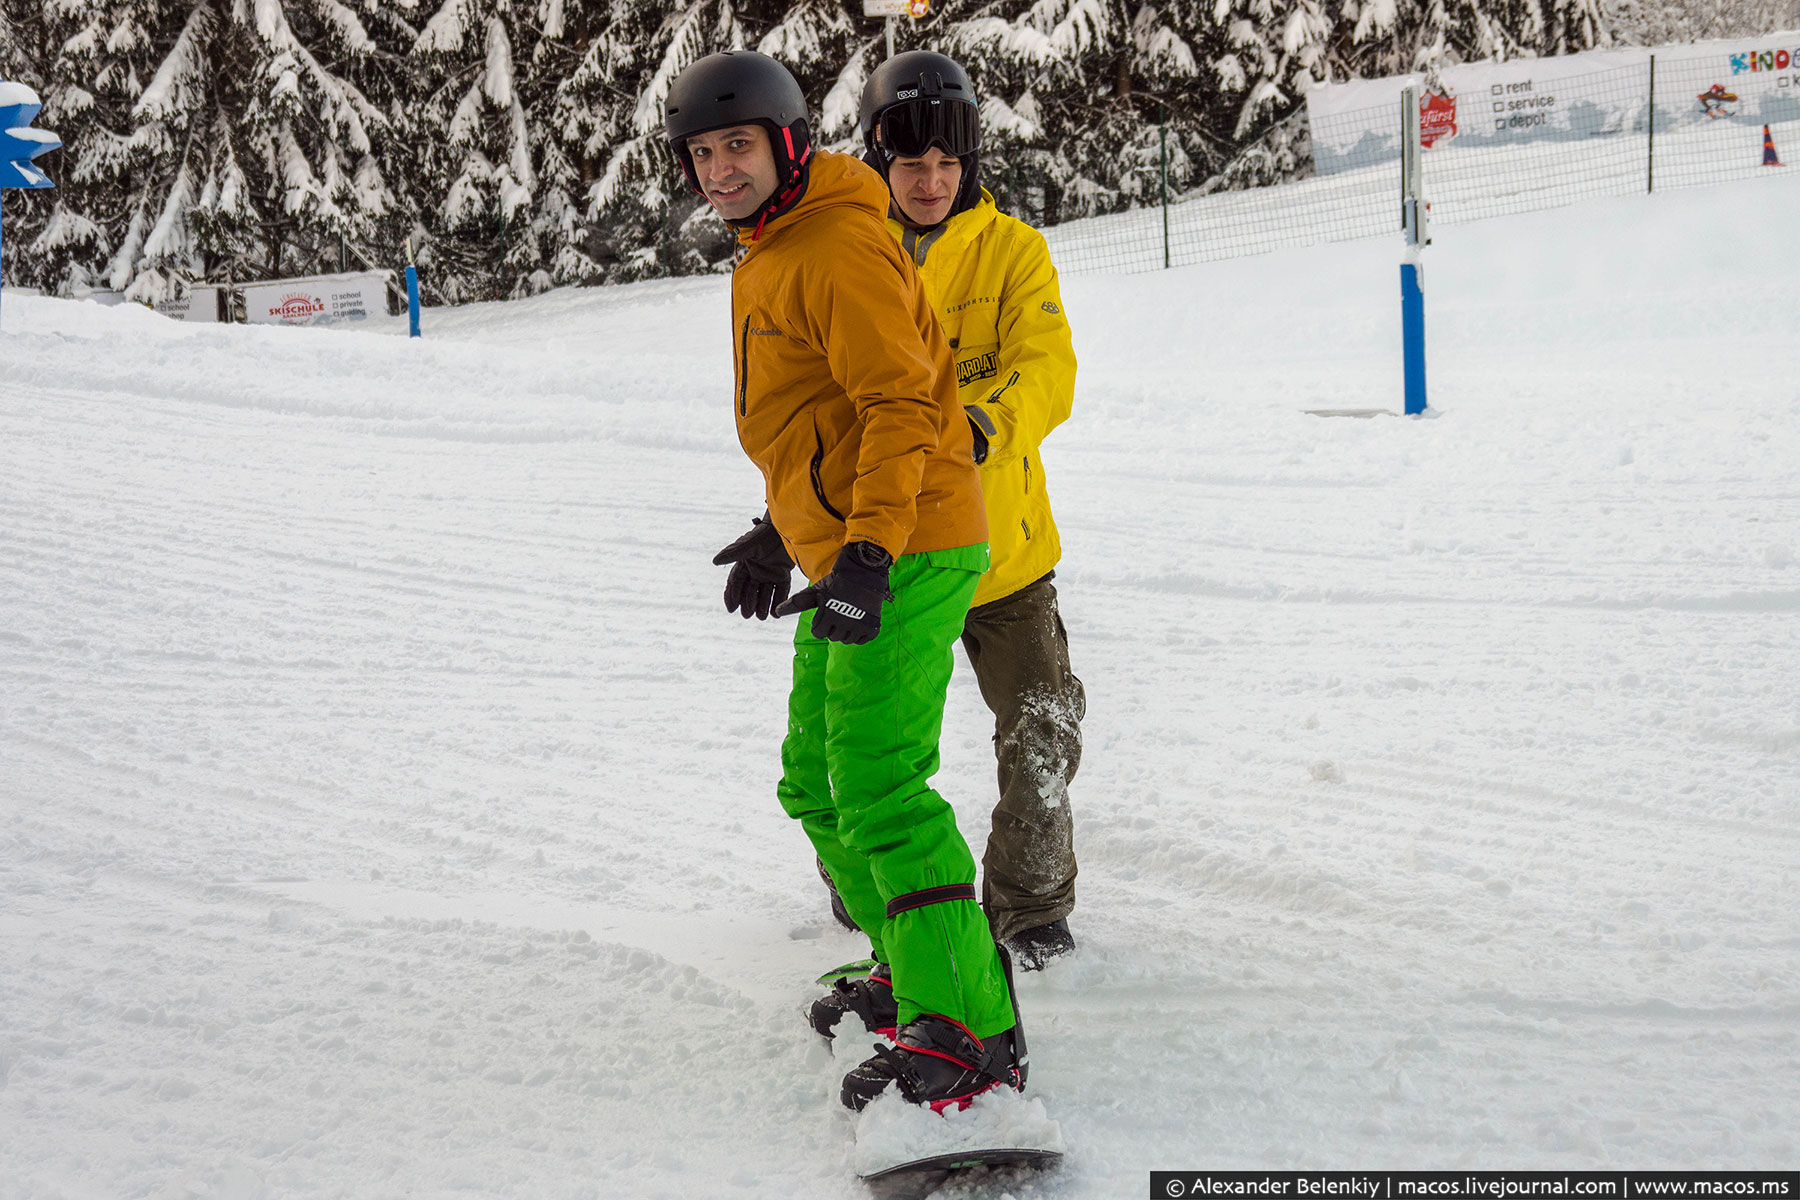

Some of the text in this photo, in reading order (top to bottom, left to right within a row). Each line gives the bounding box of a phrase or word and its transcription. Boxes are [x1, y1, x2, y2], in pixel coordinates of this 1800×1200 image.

[1506, 79, 1532, 94] rent
[1507, 95, 1555, 112] service
[1509, 112, 1546, 129] depot
[339, 291, 361, 300] school
[167, 304, 190, 312] school
[269, 303, 325, 316] SKISCHULE
[339, 300, 363, 309] private
[340, 308, 366, 318] guiding
